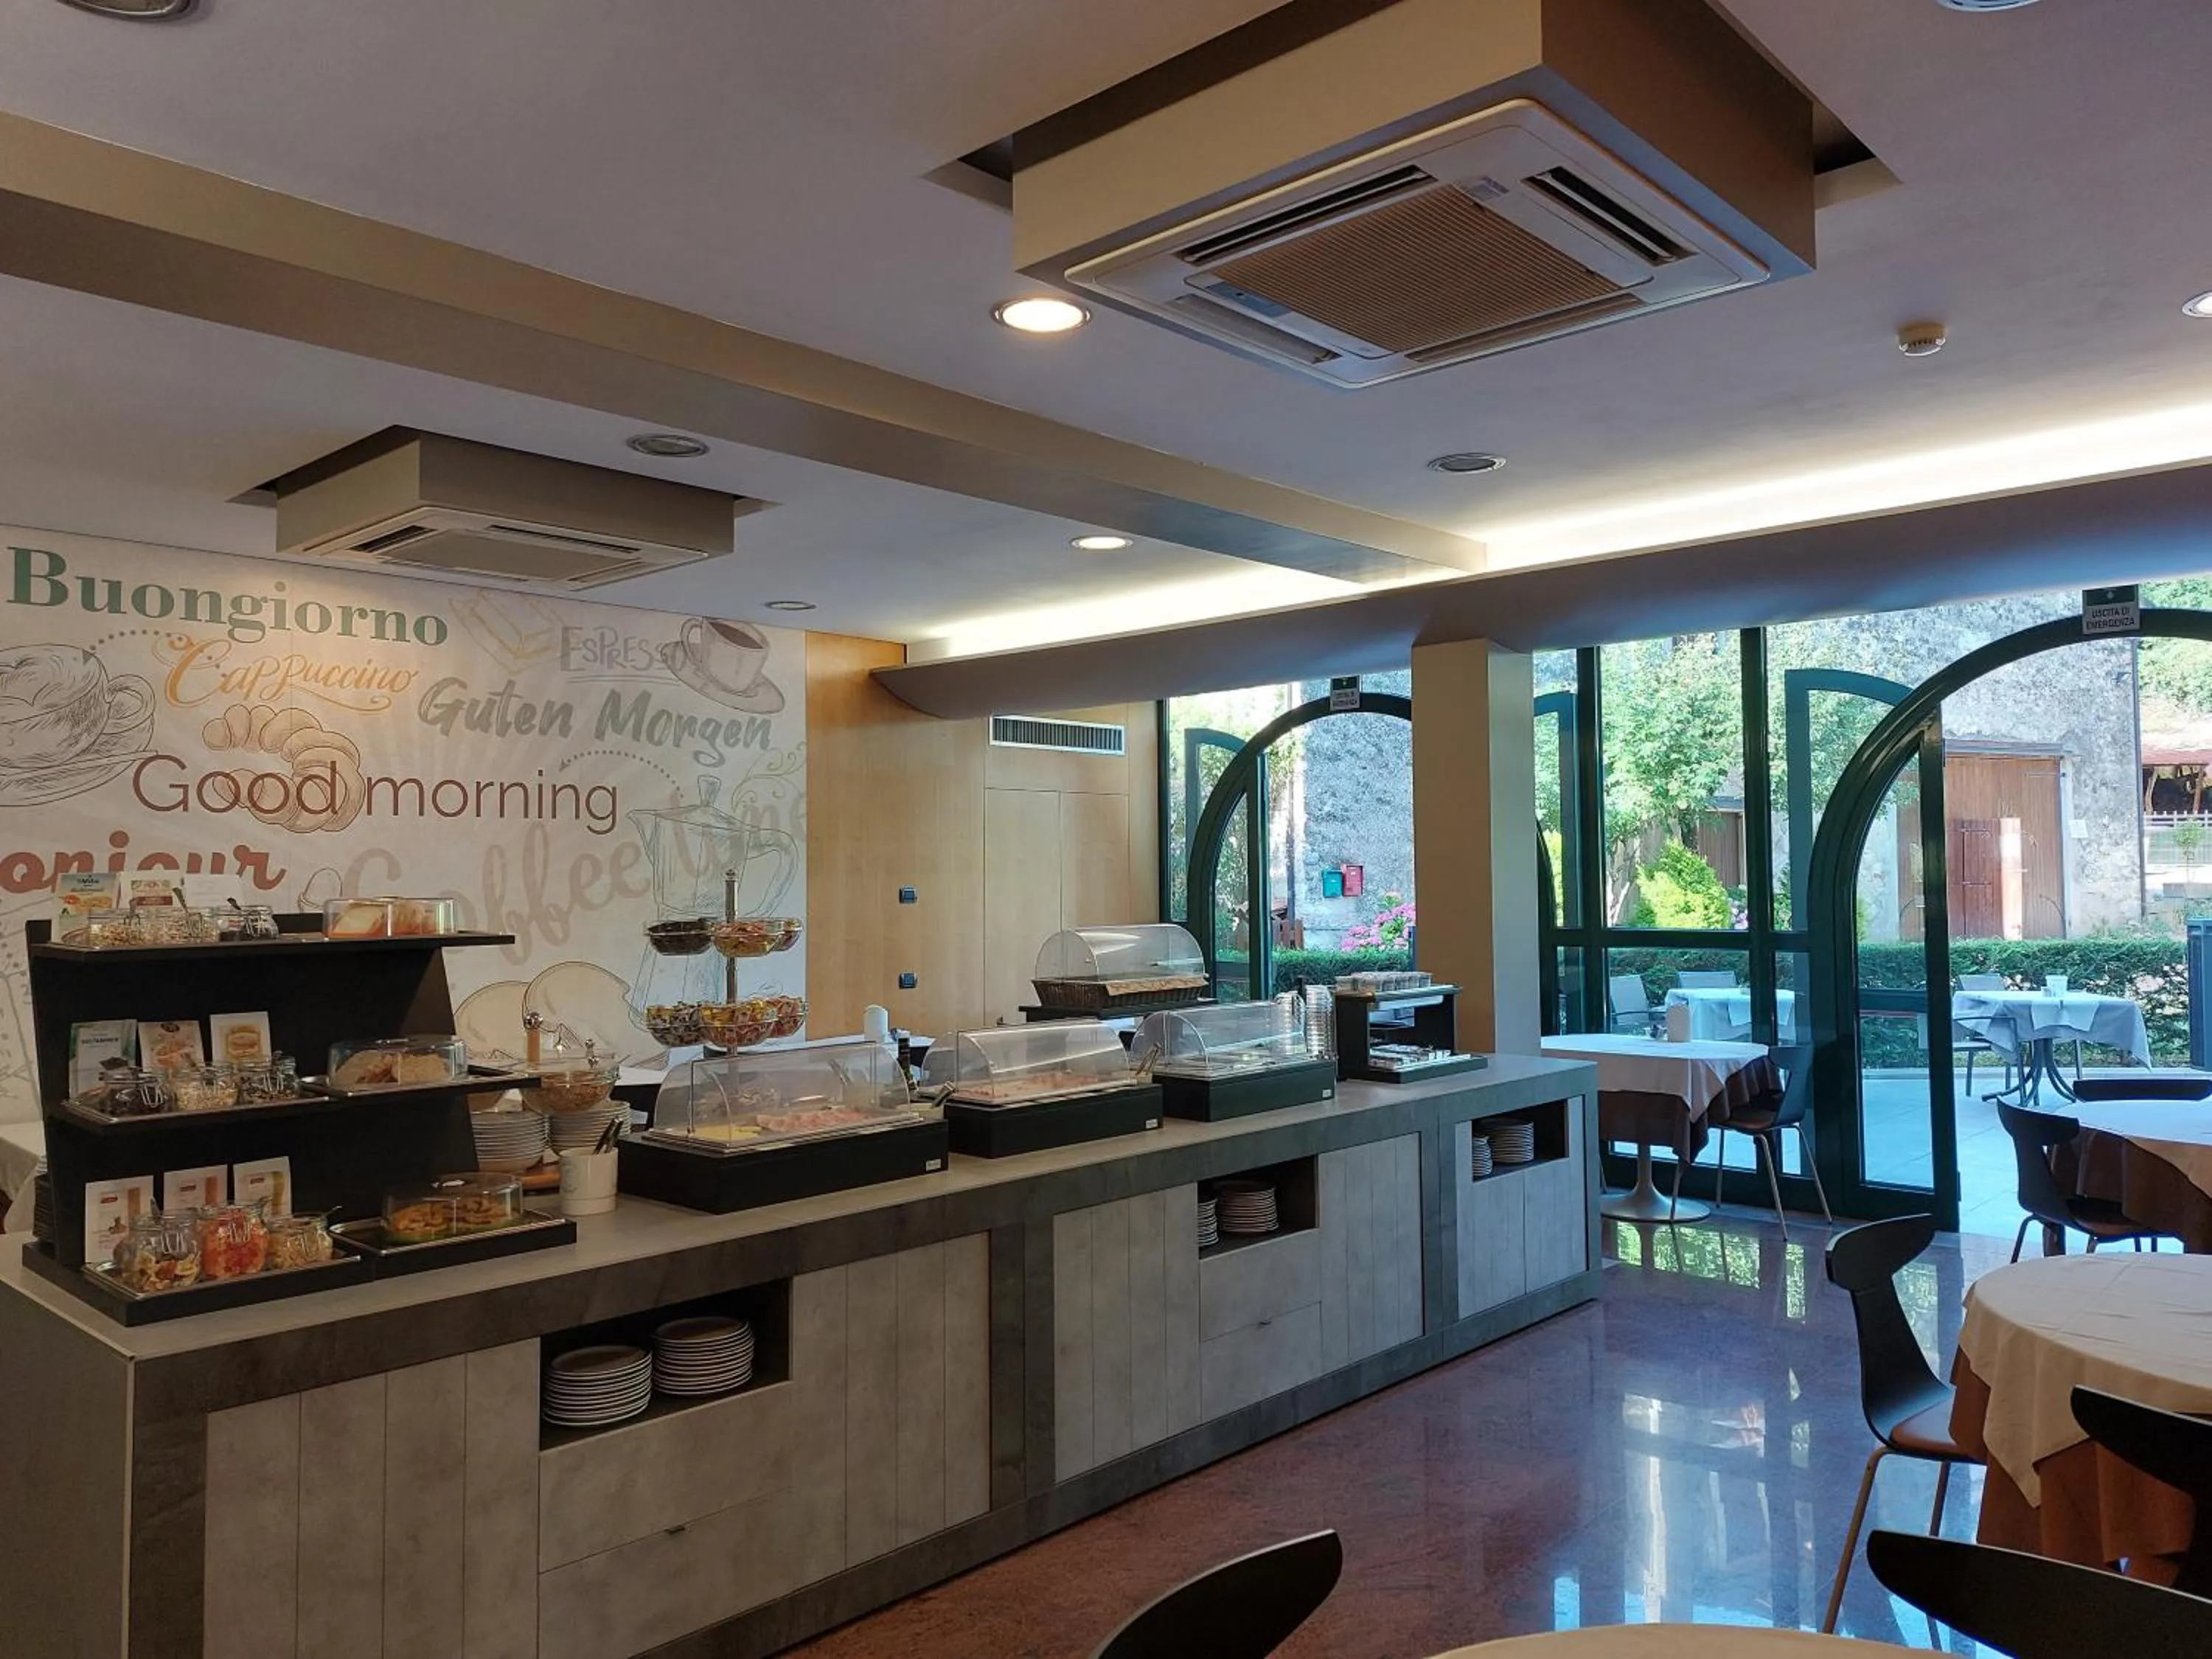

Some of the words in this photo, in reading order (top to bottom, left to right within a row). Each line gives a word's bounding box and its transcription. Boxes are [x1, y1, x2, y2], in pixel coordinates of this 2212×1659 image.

[7, 546, 448, 647] Buongiorno
[418, 677, 574, 739] Guten
[594, 689, 771, 768] Morgen
[132, 754, 338, 815] Good
[366, 769, 617, 835] morning
